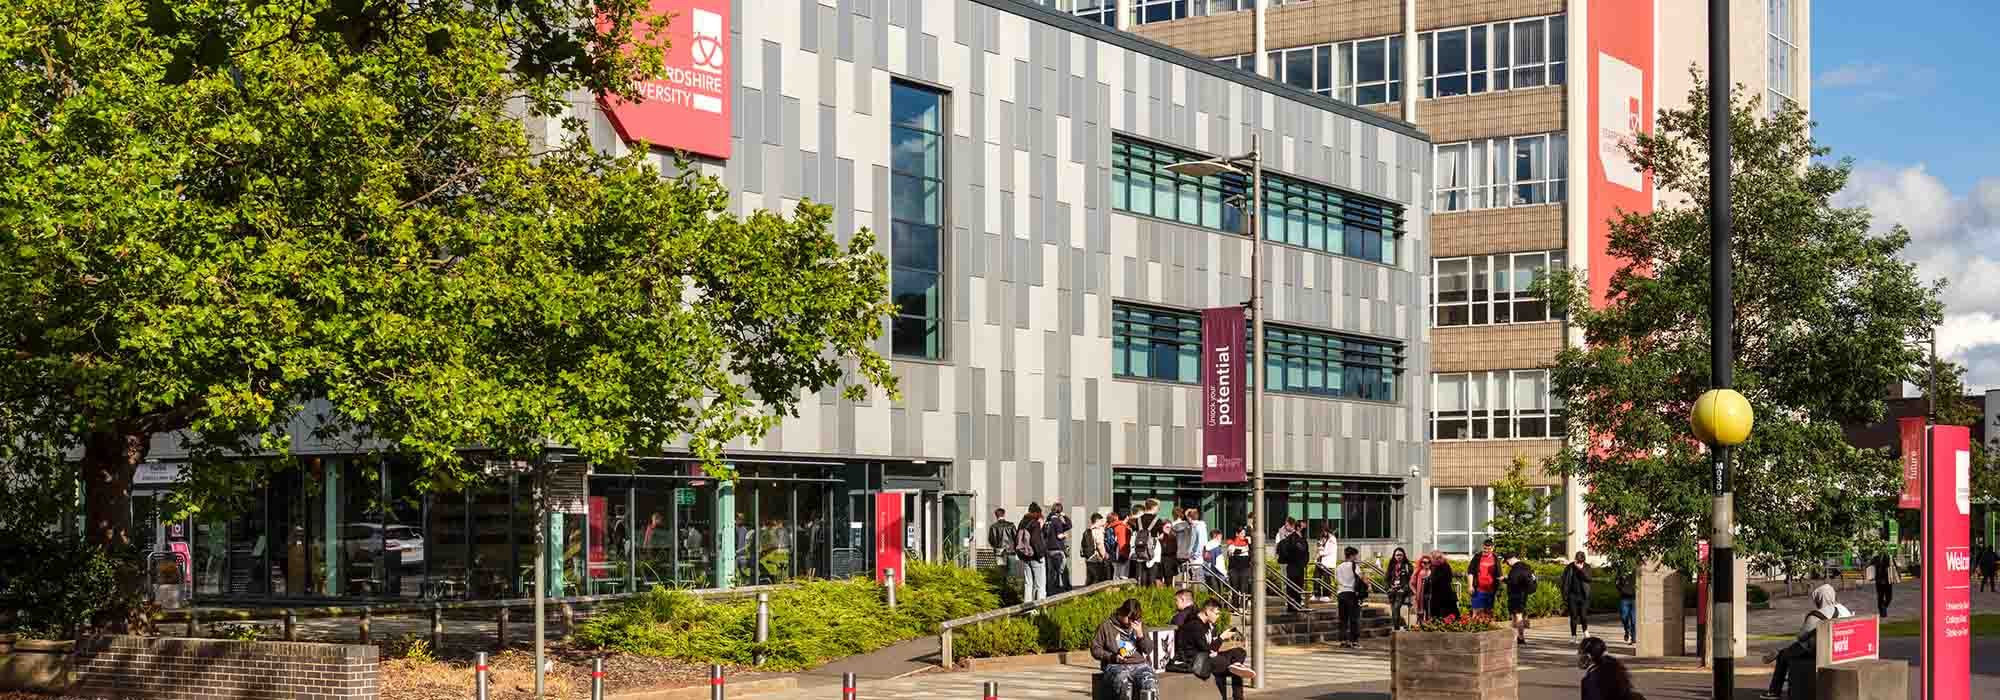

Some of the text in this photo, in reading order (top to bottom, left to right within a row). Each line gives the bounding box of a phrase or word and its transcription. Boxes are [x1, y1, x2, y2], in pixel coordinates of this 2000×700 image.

[626, 80, 691, 106] NIVERSITY
[657, 65, 722, 93] RDSHIRE
[1216, 346, 1232, 425] potential
[1909, 450, 1917, 480] future
